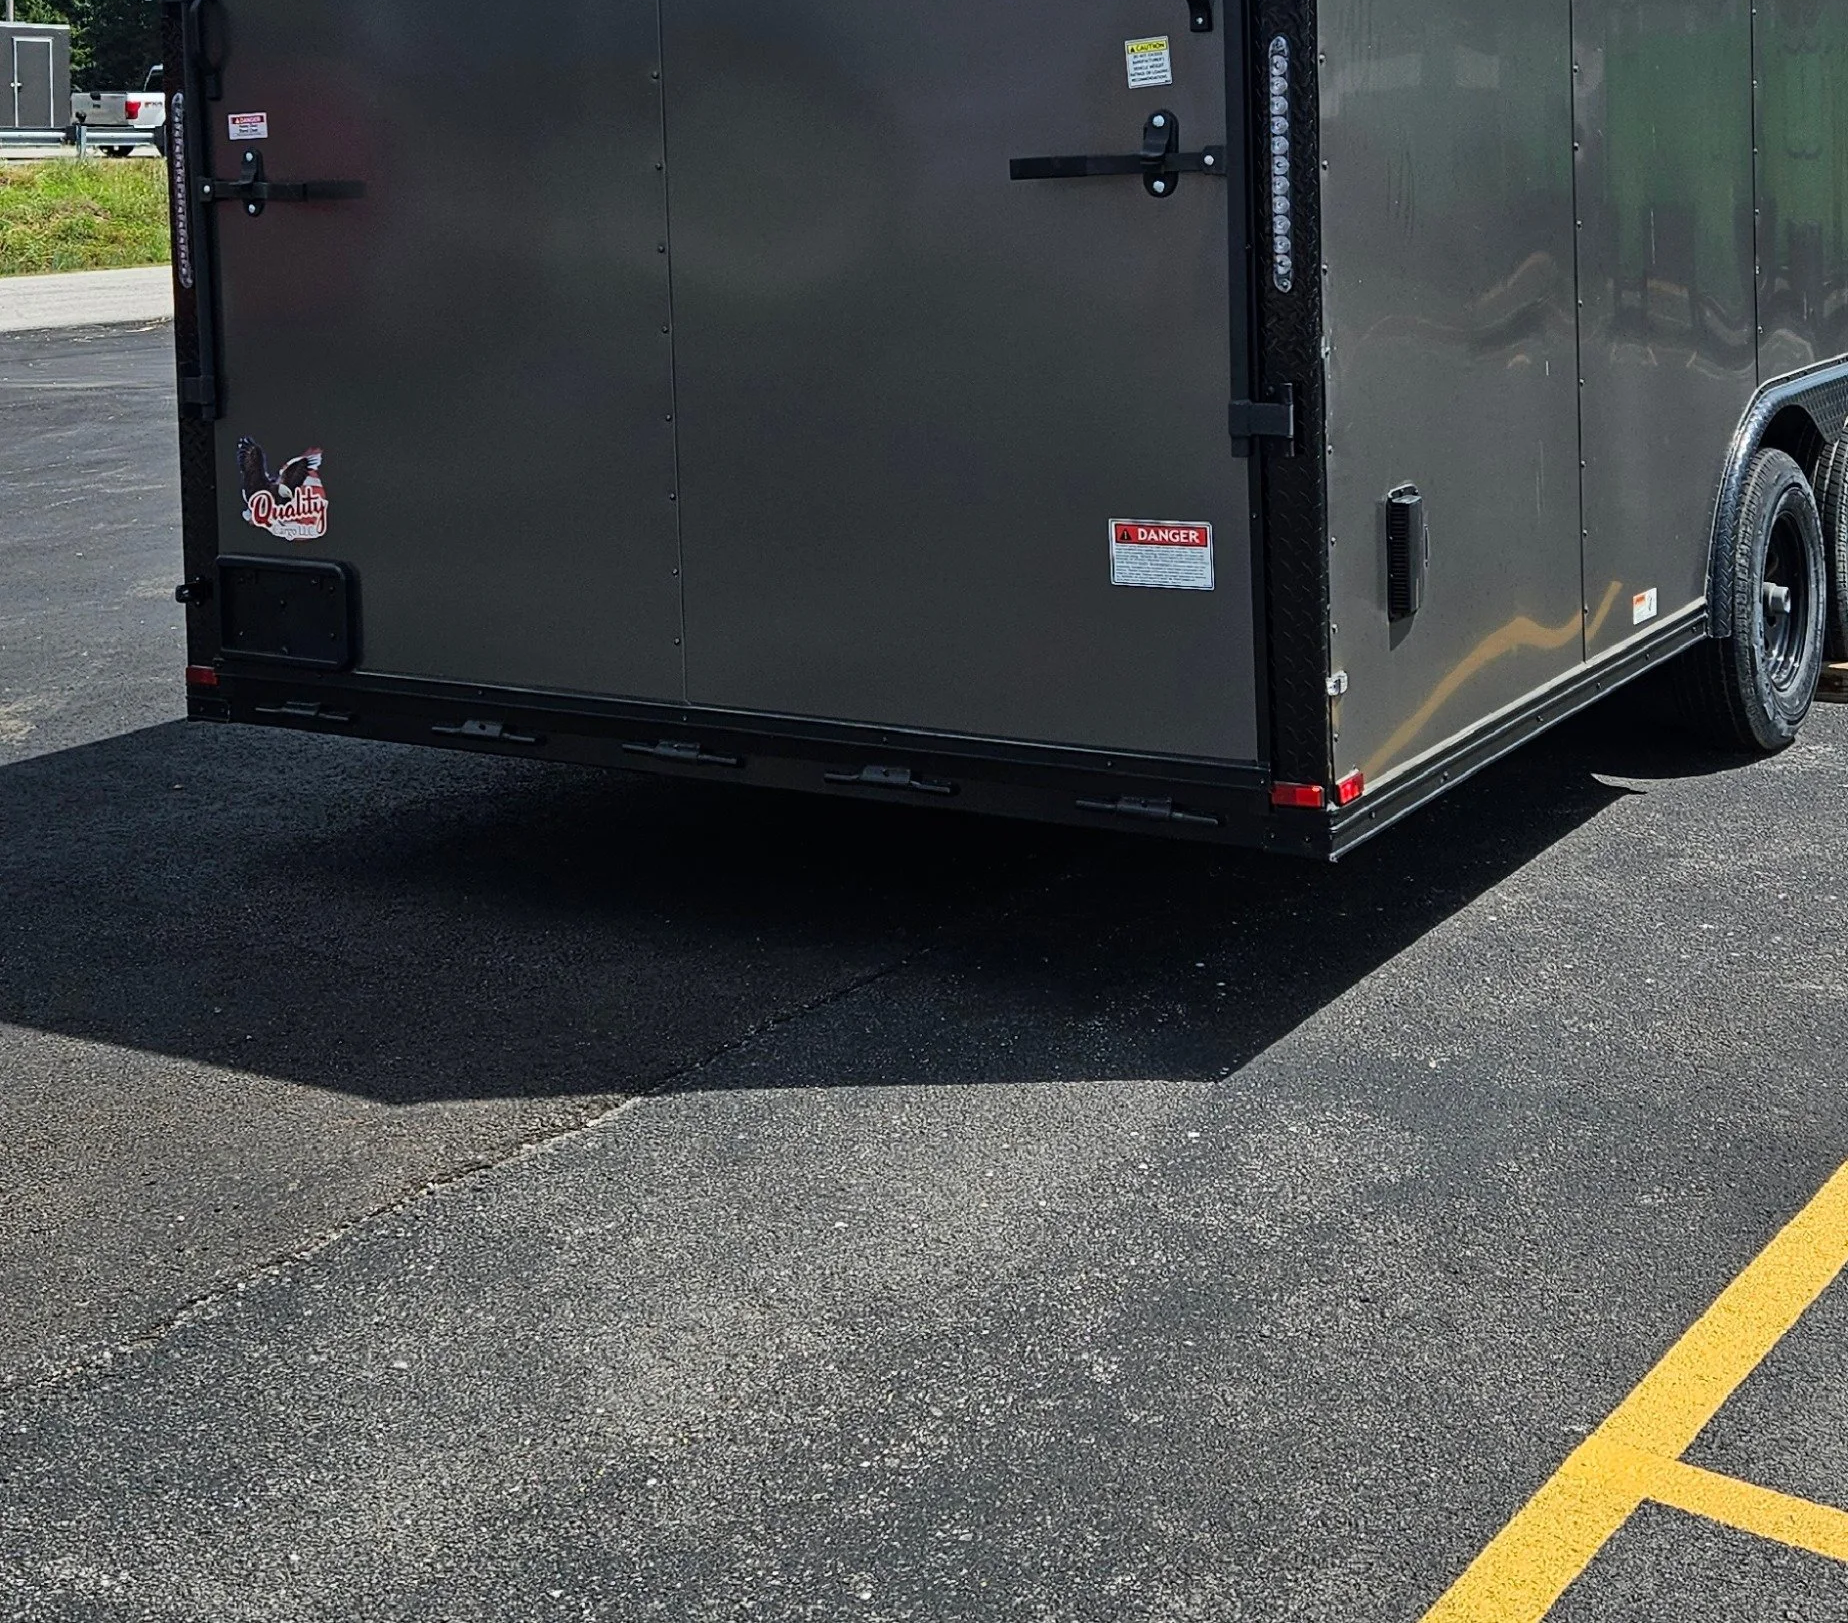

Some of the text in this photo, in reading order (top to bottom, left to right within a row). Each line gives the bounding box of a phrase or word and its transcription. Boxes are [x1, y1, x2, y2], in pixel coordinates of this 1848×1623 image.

[1136, 42, 1165, 52] CAUTION
[250, 488, 325, 534] Quality
[273, 524, 297, 538] Cargo
[1138, 528, 1200, 543] DANGER
